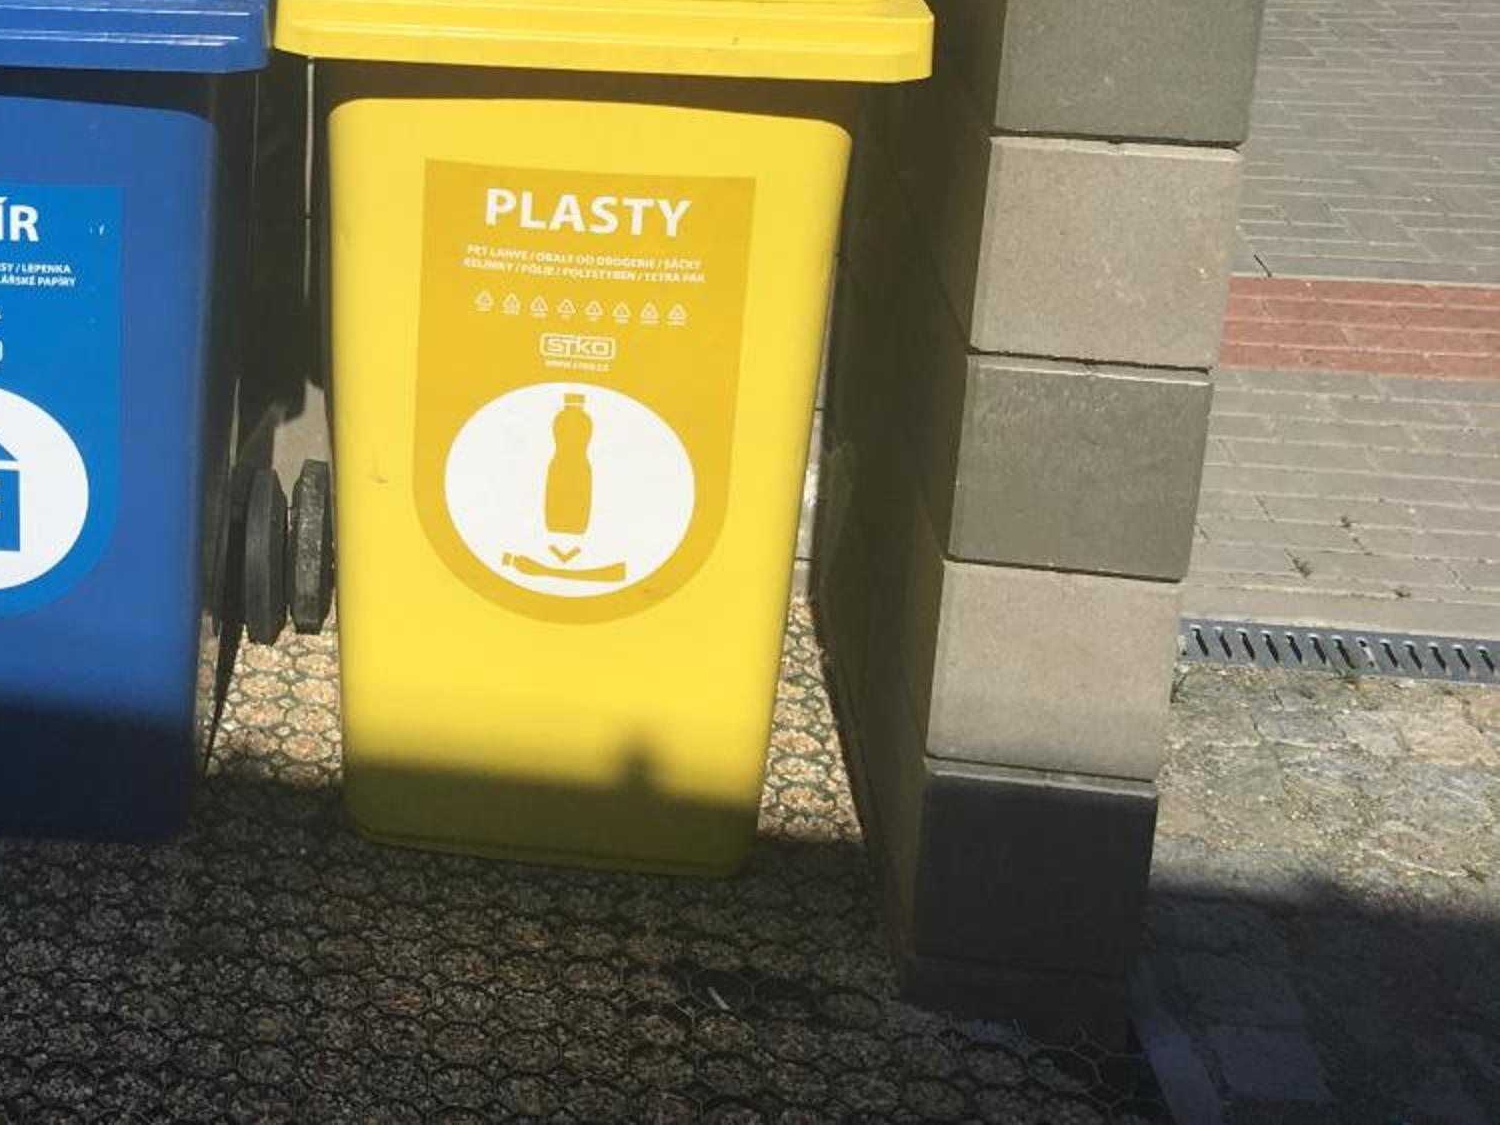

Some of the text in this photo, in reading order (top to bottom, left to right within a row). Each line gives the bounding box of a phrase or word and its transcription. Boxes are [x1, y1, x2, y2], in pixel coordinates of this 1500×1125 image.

[484, 187, 692, 238] PLASTY
[21, 262, 71, 274] LEPENKA
[37, 275, 77, 288] PAPÍRY
[545, 335, 611, 358] STKO
